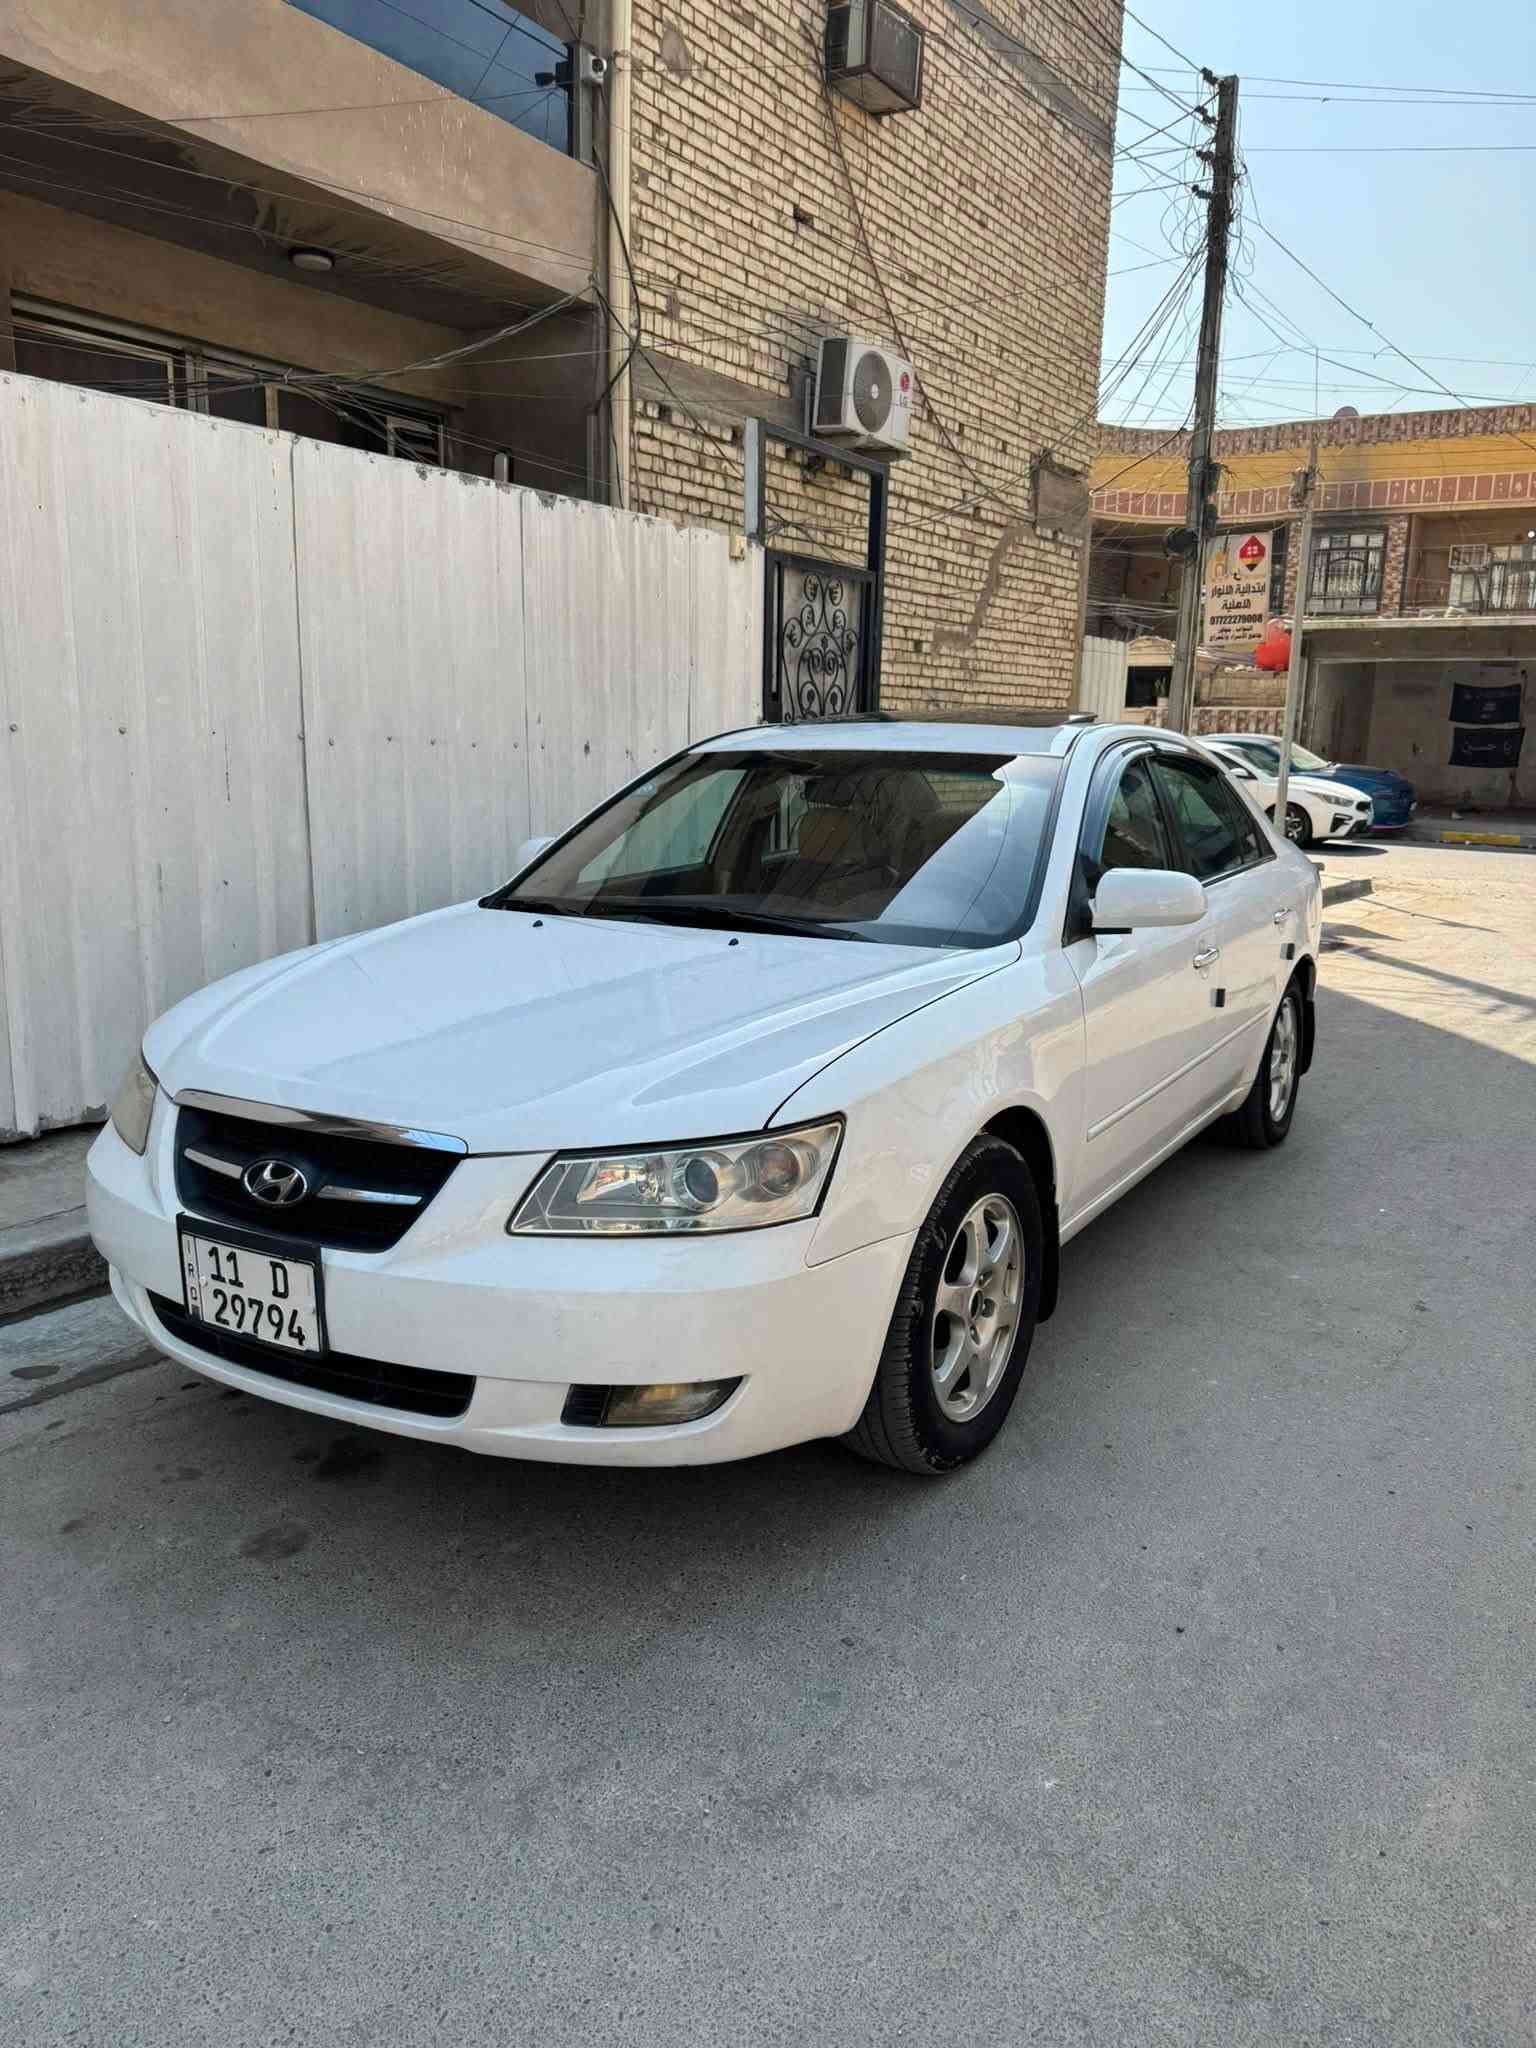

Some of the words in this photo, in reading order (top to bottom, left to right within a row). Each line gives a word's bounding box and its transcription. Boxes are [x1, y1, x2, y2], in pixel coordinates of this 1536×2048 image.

[208, 1246, 244, 1288] 11
[269, 1260, 290, 1299] D
[212, 1288, 306, 1346] 29794
